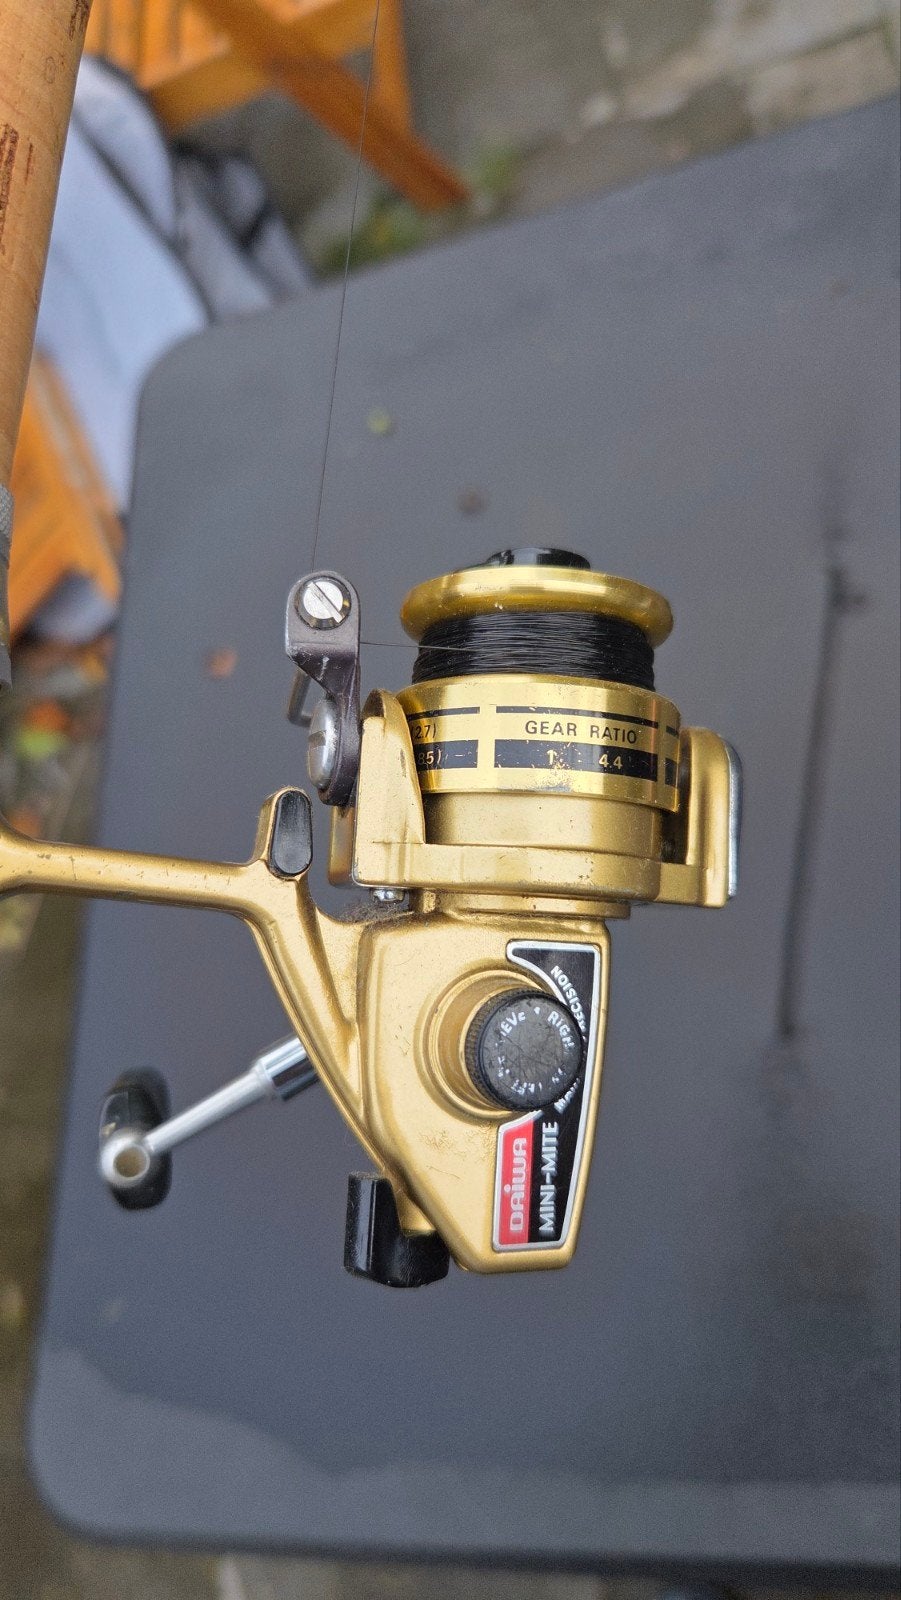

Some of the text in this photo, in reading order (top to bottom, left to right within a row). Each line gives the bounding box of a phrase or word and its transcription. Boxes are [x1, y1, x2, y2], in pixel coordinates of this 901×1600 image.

[525, 720, 637, 744] GEAR RATIO
[550, 965, 586, 1033] RECISION
[547, 1010, 575, 1054] RIGH
[538, 1121, 559, 1232] MINI-MITE
